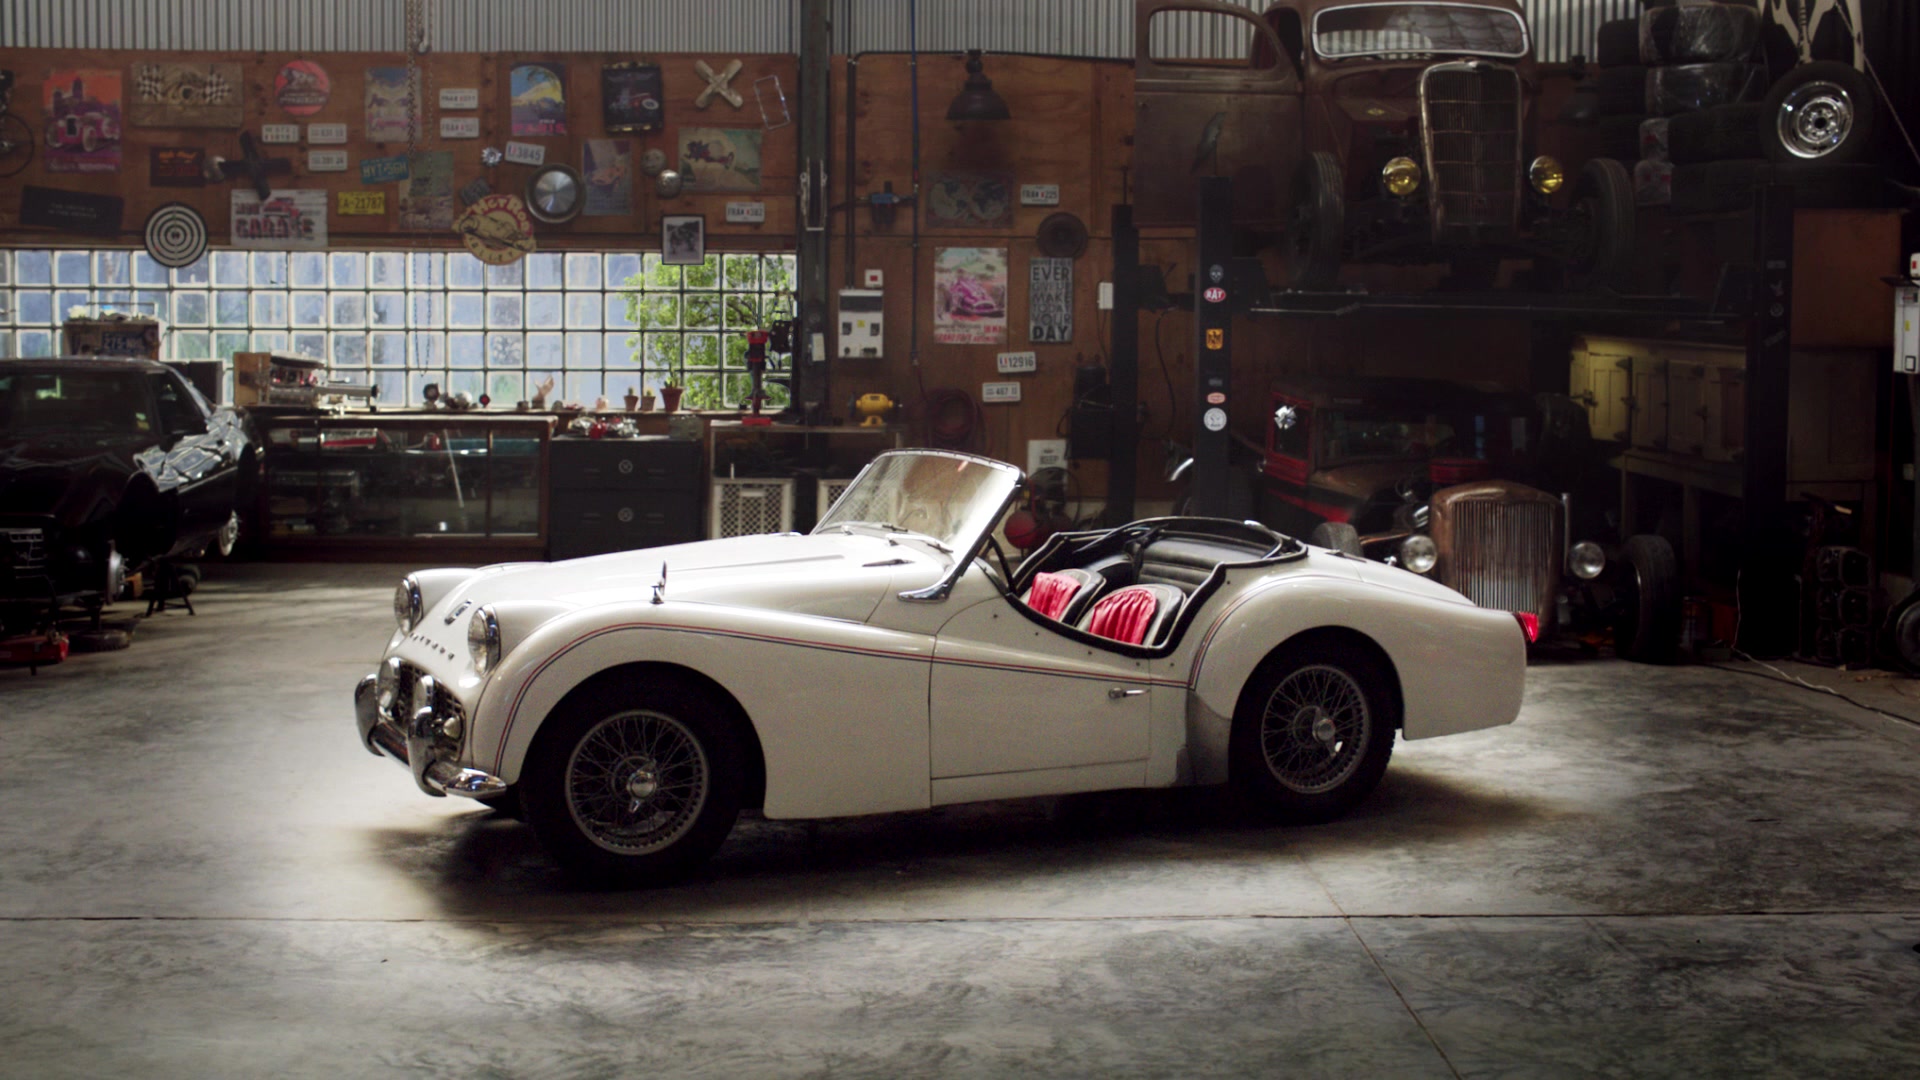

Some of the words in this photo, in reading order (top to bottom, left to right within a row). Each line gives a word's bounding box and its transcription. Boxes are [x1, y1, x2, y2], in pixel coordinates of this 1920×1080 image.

[1032, 267, 1070, 281] EVER
[1032, 293, 1071, 303] MAKE
[1032, 304, 1070, 313] TODAY
[1032, 314, 1071, 326] YOUR
[1032, 326, 1068, 340] DAY
